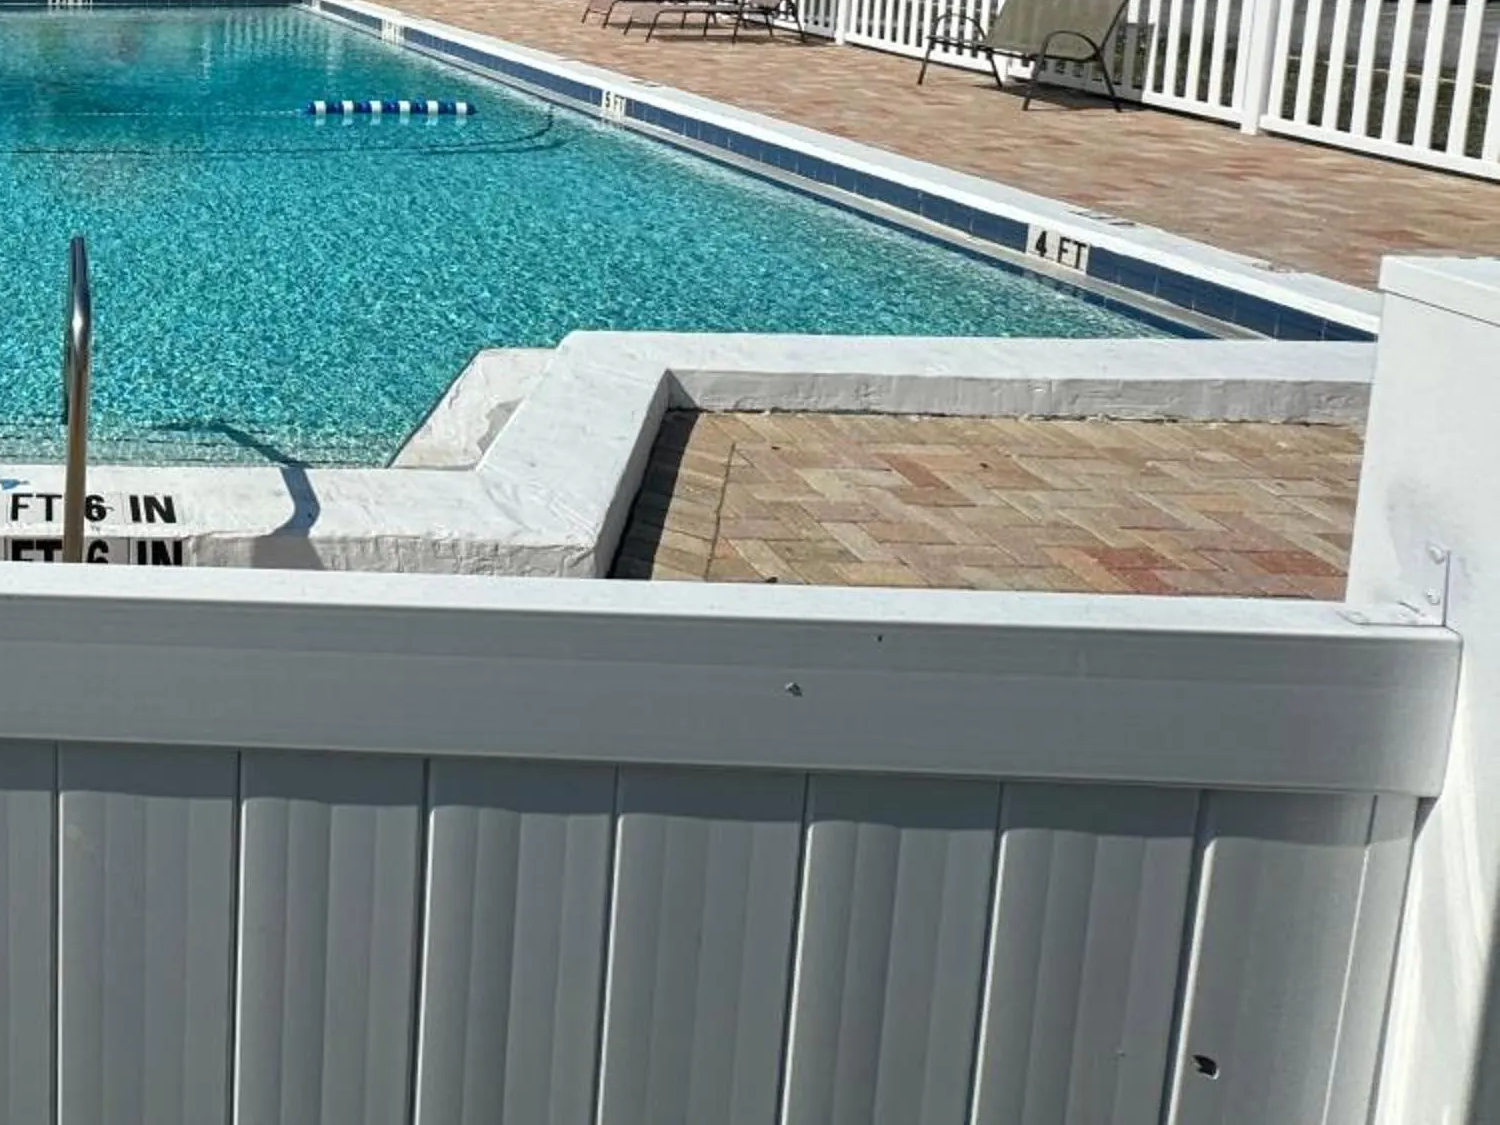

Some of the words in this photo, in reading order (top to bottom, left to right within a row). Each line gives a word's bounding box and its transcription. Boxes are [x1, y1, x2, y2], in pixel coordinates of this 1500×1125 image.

[1035, 230, 1047, 257] 4
[1057, 236, 1087, 269] FT
[10, 493, 63, 522] FT
[85, 494, 107, 522] 6
[129, 495, 177, 523] IN
[10, 540, 63, 564] FT
[137, 541, 183, 566] IN
